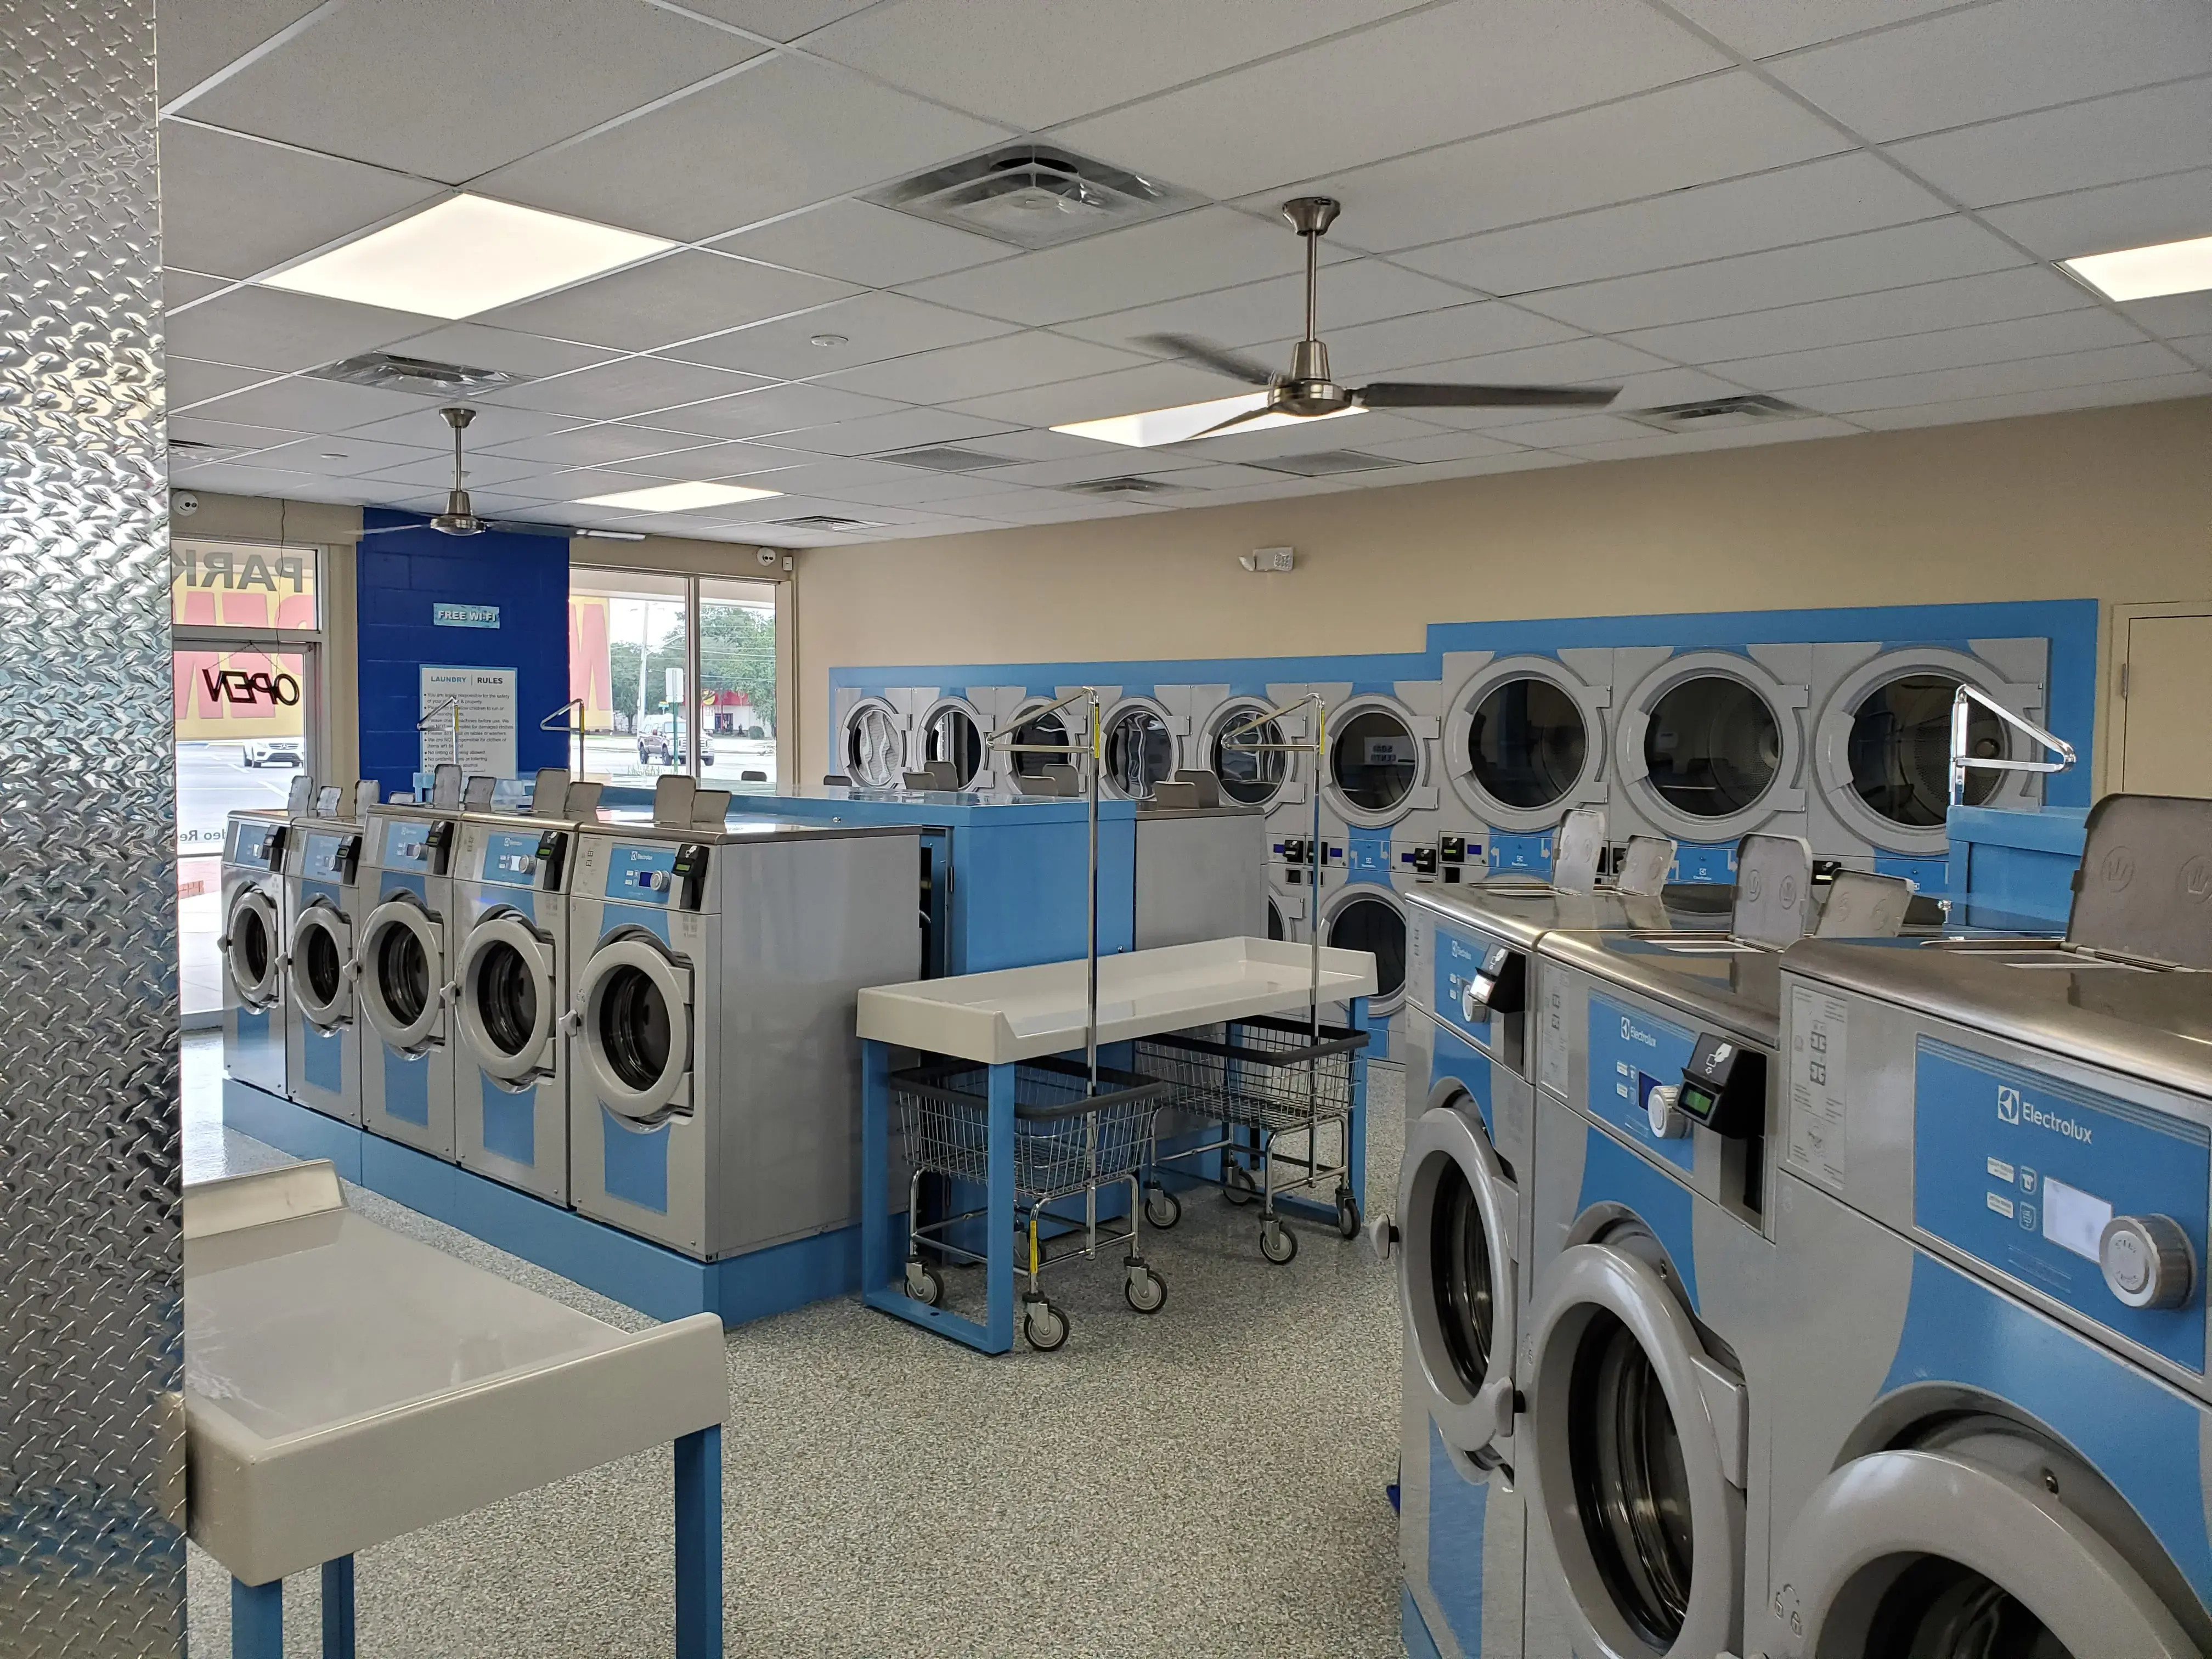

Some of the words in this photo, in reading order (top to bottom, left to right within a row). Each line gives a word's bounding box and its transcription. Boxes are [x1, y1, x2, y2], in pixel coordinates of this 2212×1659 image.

[438, 611, 466, 620] FREE
[470, 612, 496, 621] WI-FI
[2023, 1102, 2092, 1144] Electrolux
